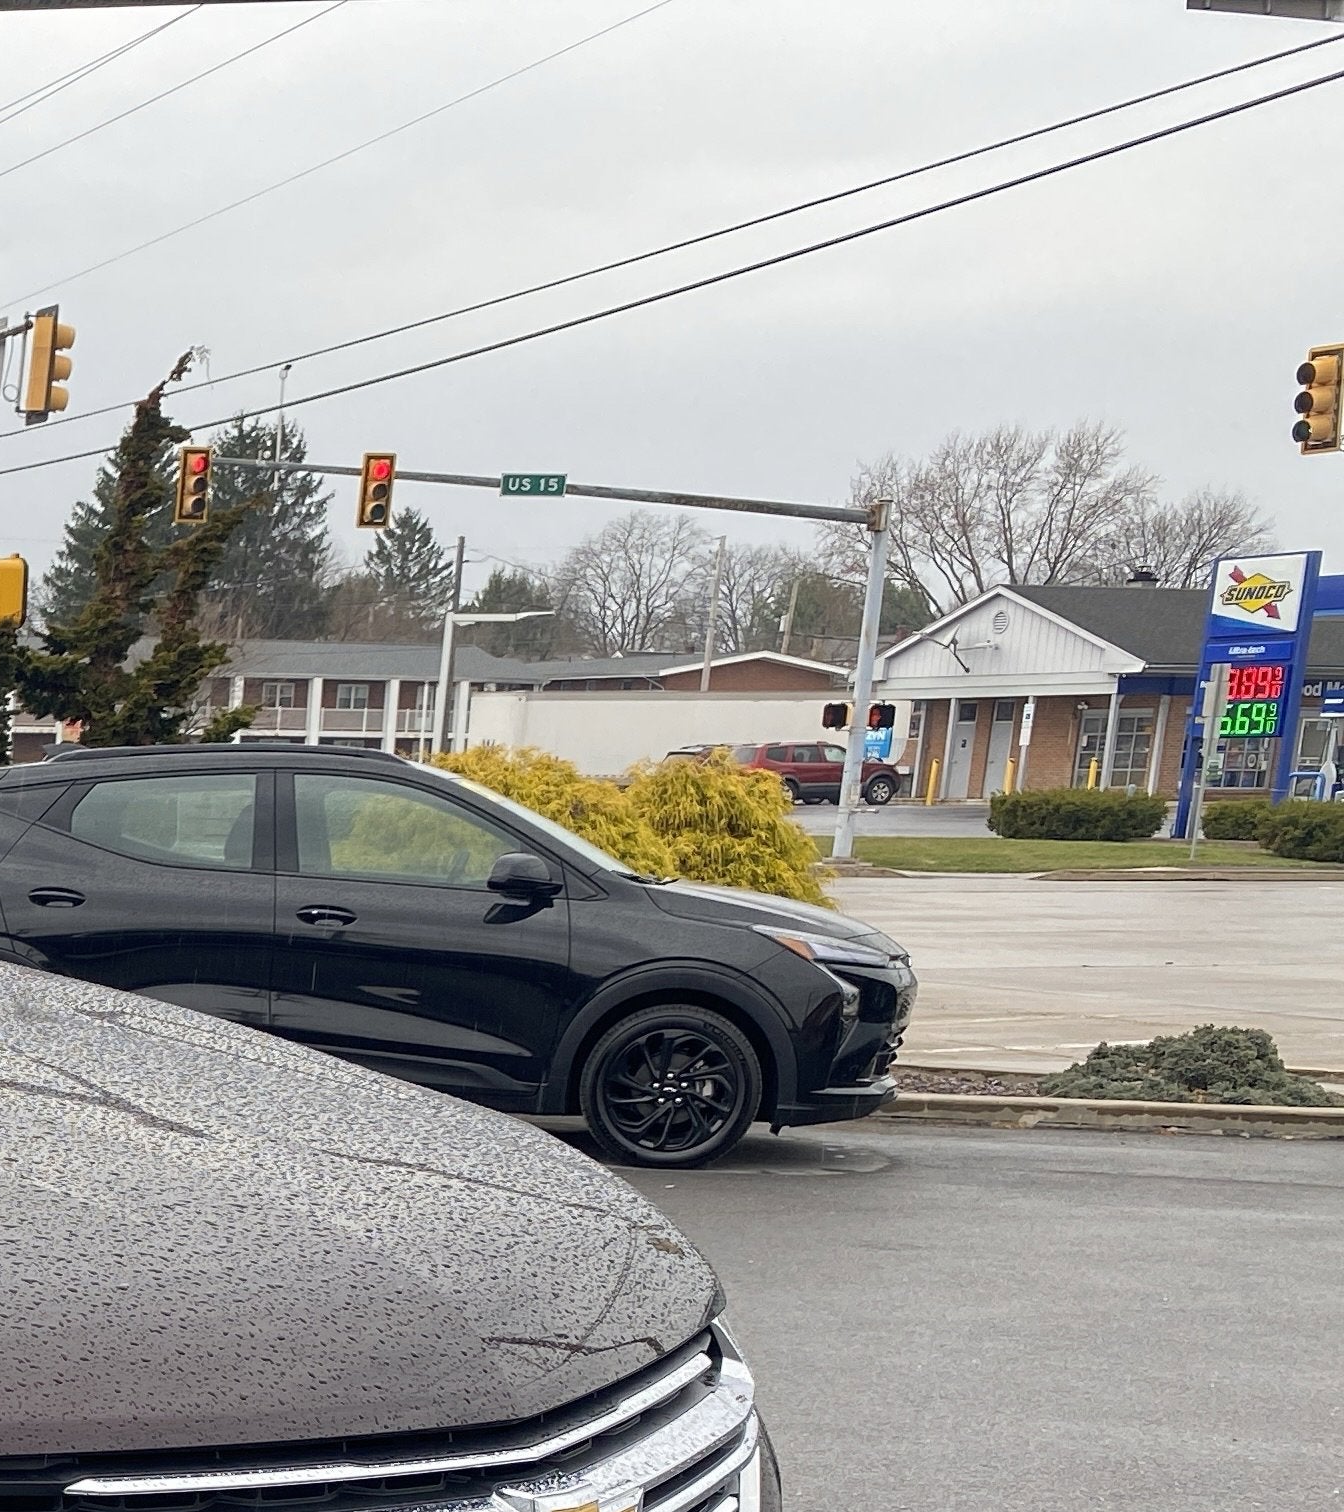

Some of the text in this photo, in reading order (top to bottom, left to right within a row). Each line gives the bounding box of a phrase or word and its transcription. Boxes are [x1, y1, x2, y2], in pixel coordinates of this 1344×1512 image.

[508, 477, 558, 491] US 15
[1225, 584, 1286, 601] SUNOCO
